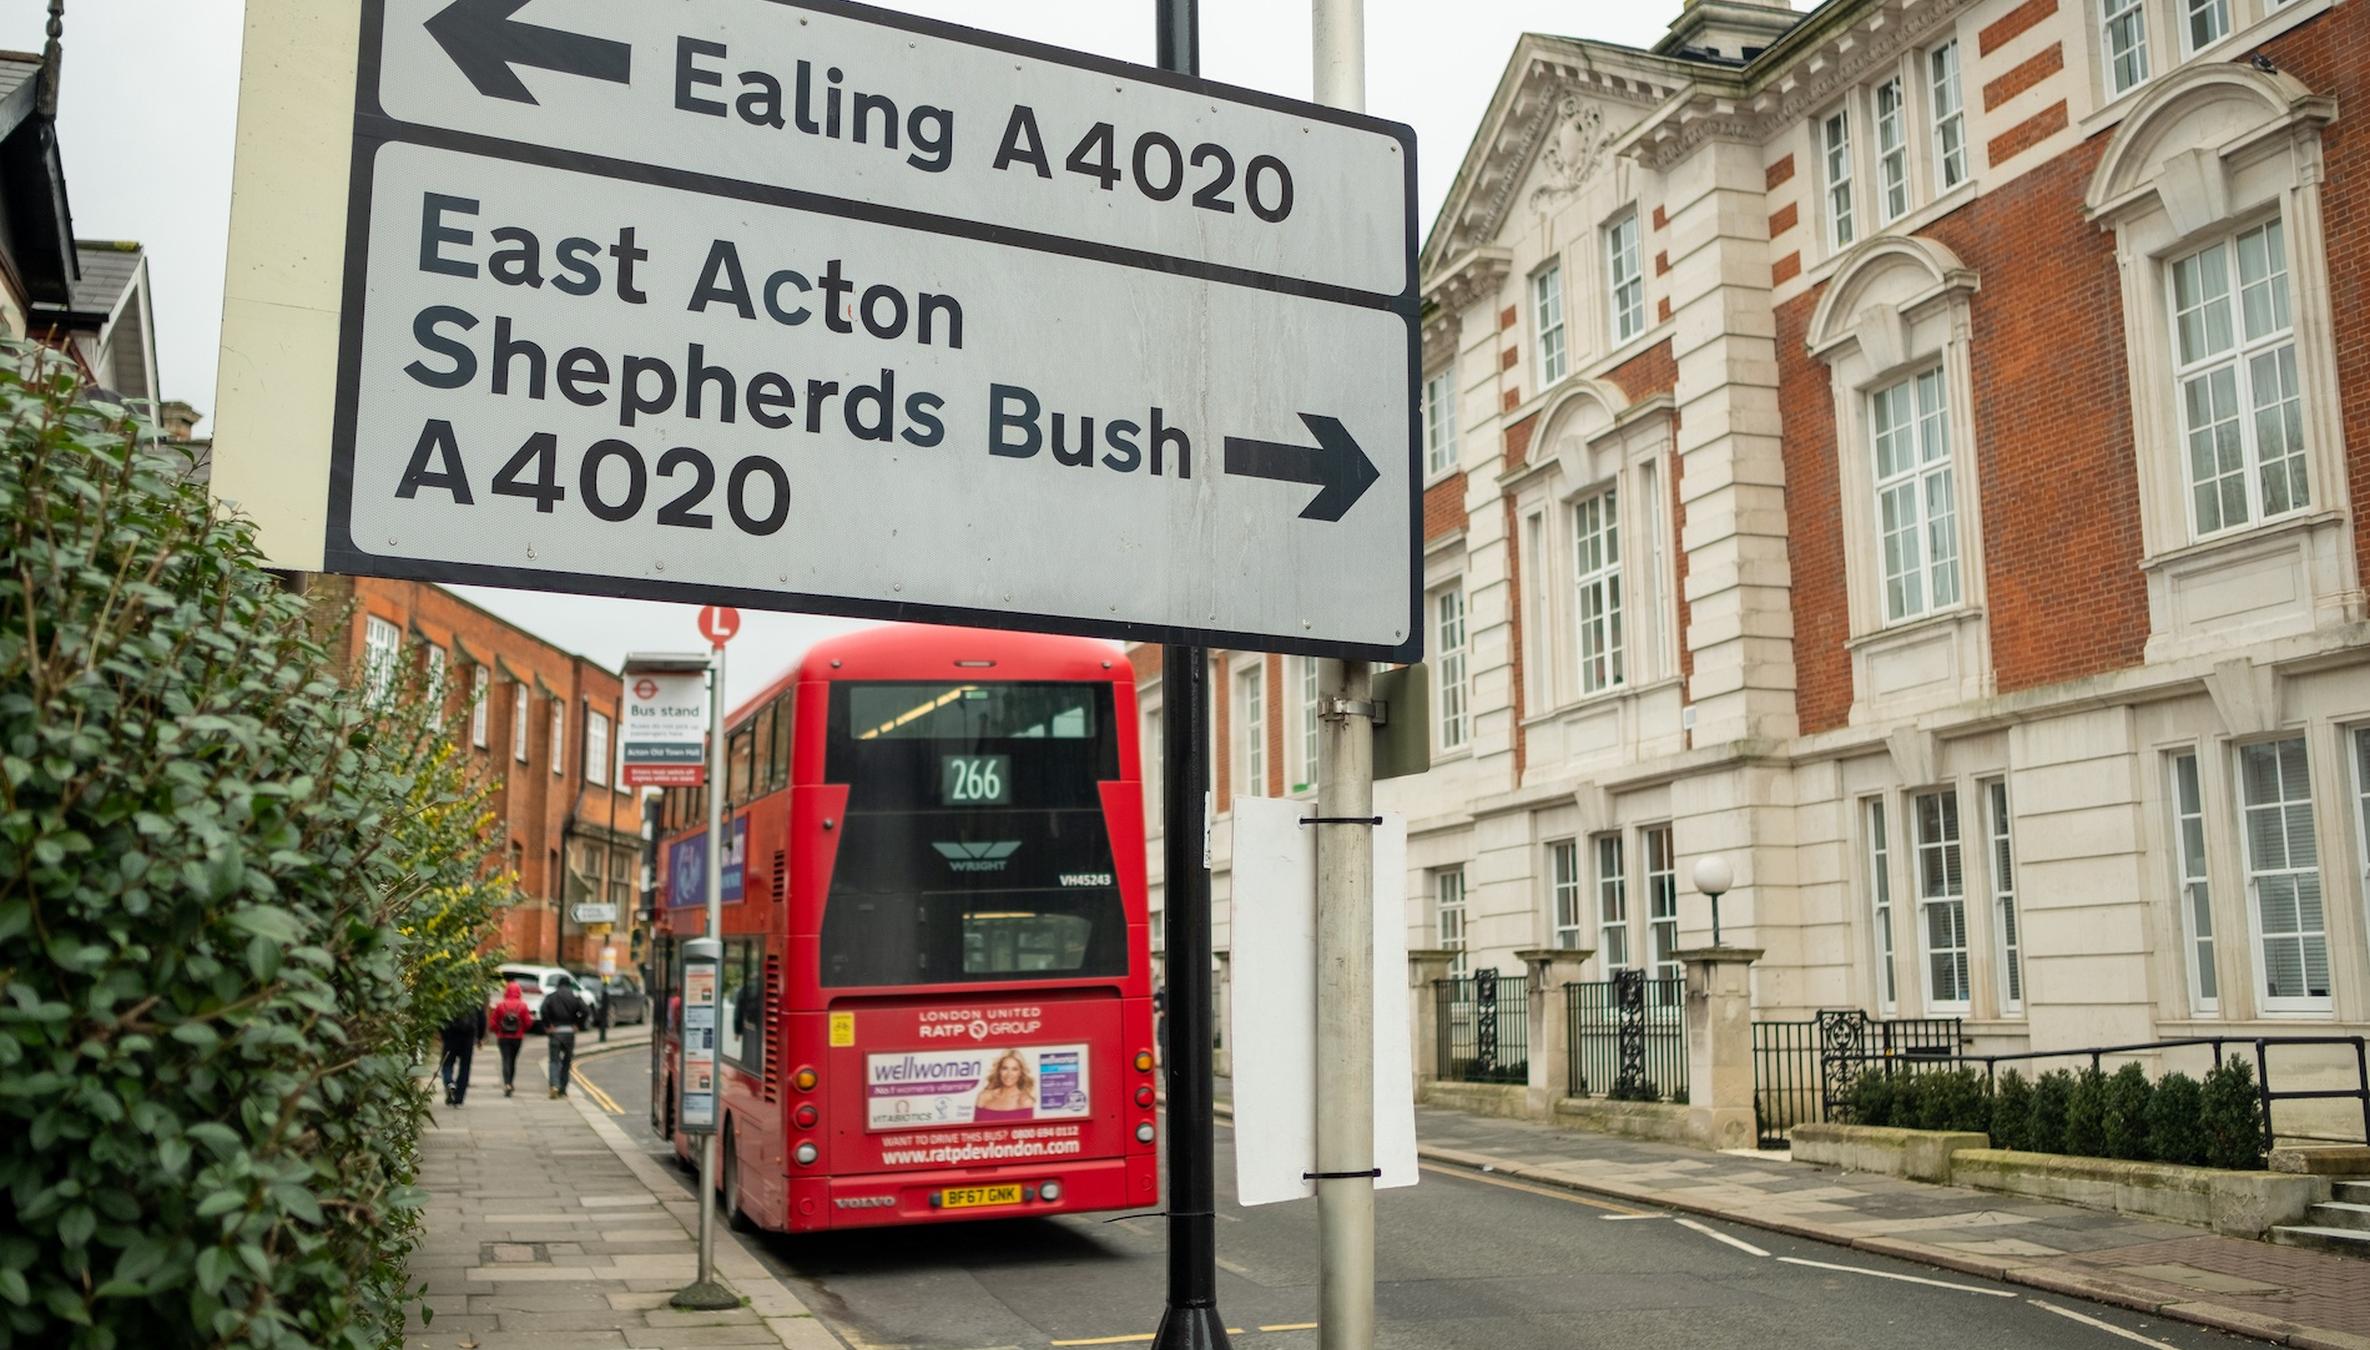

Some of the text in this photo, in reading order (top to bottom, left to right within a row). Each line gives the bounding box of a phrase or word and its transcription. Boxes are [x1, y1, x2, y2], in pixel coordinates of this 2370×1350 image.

[675, 35, 1295, 223] Ealing A4020
[419, 191, 963, 349] East Acton
[403, 305, 1191, 479] Shepherds Bush
[395, 418, 791, 536] A4020
[712, 606, 730, 635] L
[631, 704, 699, 717] Bus stand
[627, 748, 700, 757] Acton Old Town Hall
[952, 759, 1000, 800] 266
[950, 861, 1006, 871] WRIGHT
[1059, 874, 1111, 887] VH45243
[919, 1008, 1040, 1022] LONDON UNITED
[919, 1021, 1041, 1038] RATP GROUP
[875, 1056, 981, 1081] wellwoman
[873, 1112, 932, 1123] VITABIOTICS
[882, 1135, 913, 1147] WANT
[915, 1134, 928, 1145] TO
[931, 1133, 959, 1144] DRIVE
[961, 1131, 982, 1142] THIS
[983, 1130, 1008, 1141] BUS?
[882, 1139, 1080, 1165] www.ratpdevlondon.com
[834, 1196, 896, 1208] VOLVO
[949, 1188, 1015, 1205] BF67 GNK
